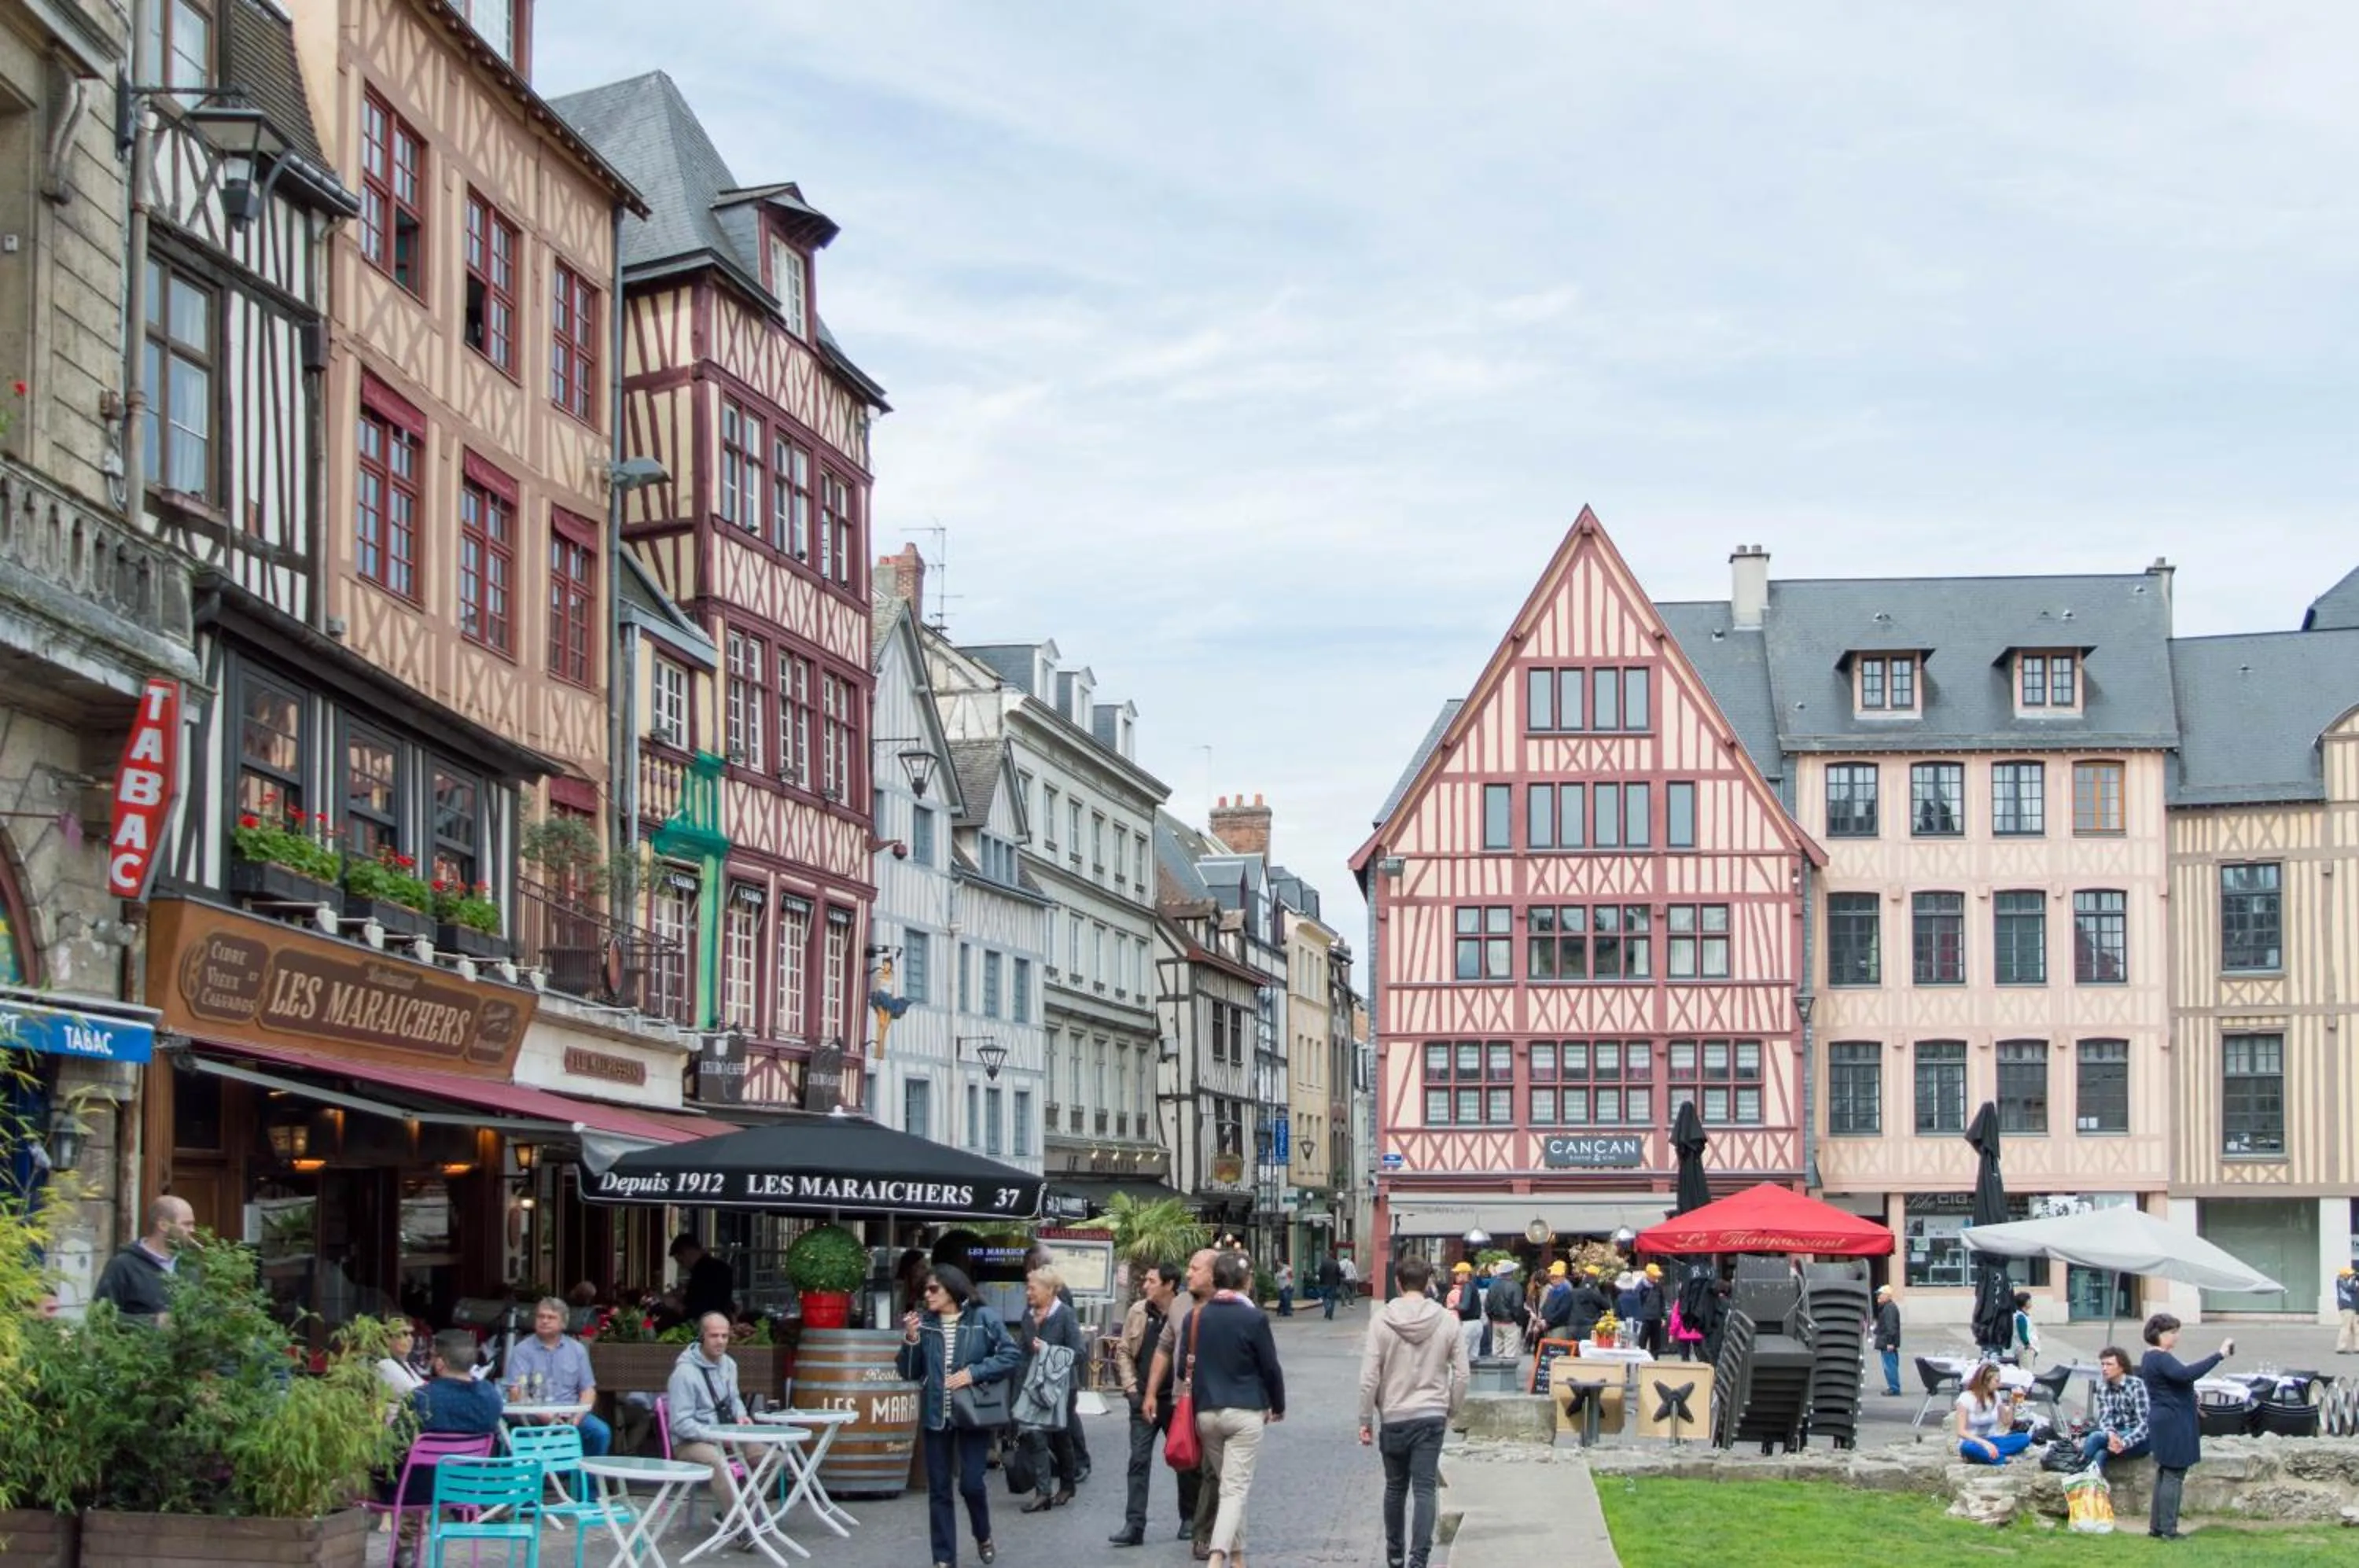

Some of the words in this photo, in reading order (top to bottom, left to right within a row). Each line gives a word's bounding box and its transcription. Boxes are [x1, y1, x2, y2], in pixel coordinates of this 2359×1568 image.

[111, 686, 172, 889] TABAC
[268, 968, 323, 1019] LES
[322, 981, 471, 1046] MARAICHERS
[64, 1025, 113, 1055] TABAC
[1550, 1139, 1636, 1154] CANCAN
[600, 1172, 669, 1195] Depuis
[675, 1173, 724, 1193] 1912
[747, 1174, 793, 1194] LES
[799, 1176, 973, 1205] MARAICHERS
[994, 1188, 1020, 1207] 37
[1676, 1232, 1708, 1248] Le
[1717, 1231, 1847, 1249] Maupassant
